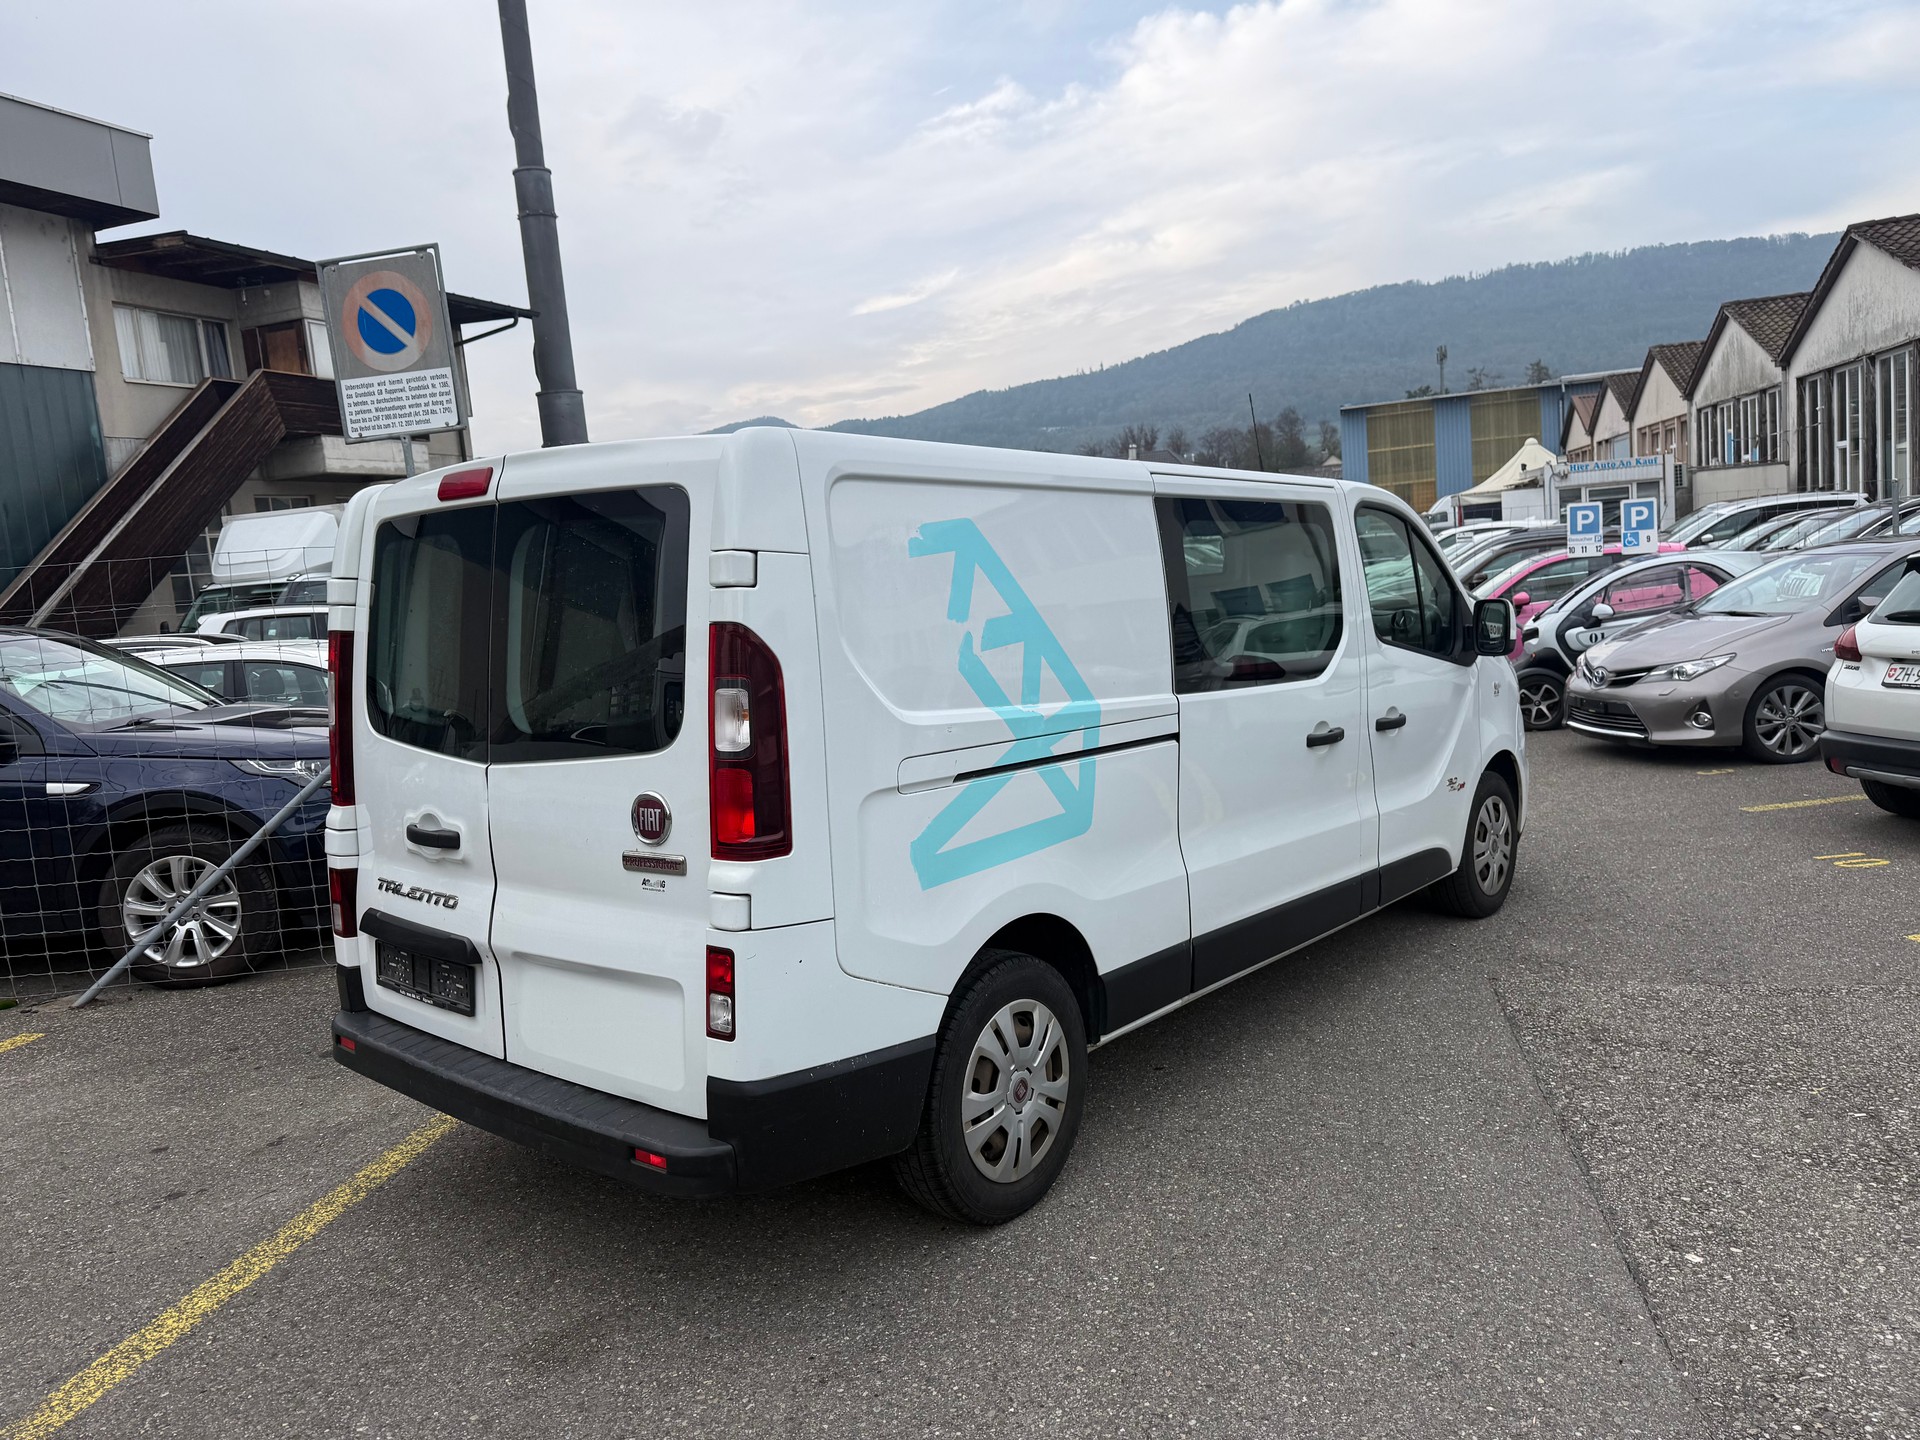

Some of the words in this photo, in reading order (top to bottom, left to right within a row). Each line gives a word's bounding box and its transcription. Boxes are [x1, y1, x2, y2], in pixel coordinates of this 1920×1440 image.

[406, 376, 427, 384] gerichtlich
[1594, 462, 1616, 470] Auto
[1619, 460, 1631, 468] An
[1636, 457, 1658, 465] Kauf
[1577, 510, 1594, 531] P
[1631, 506, 1648, 528] P
[640, 808, 661, 831] FIAT
[378, 876, 459, 909] TALENTO
